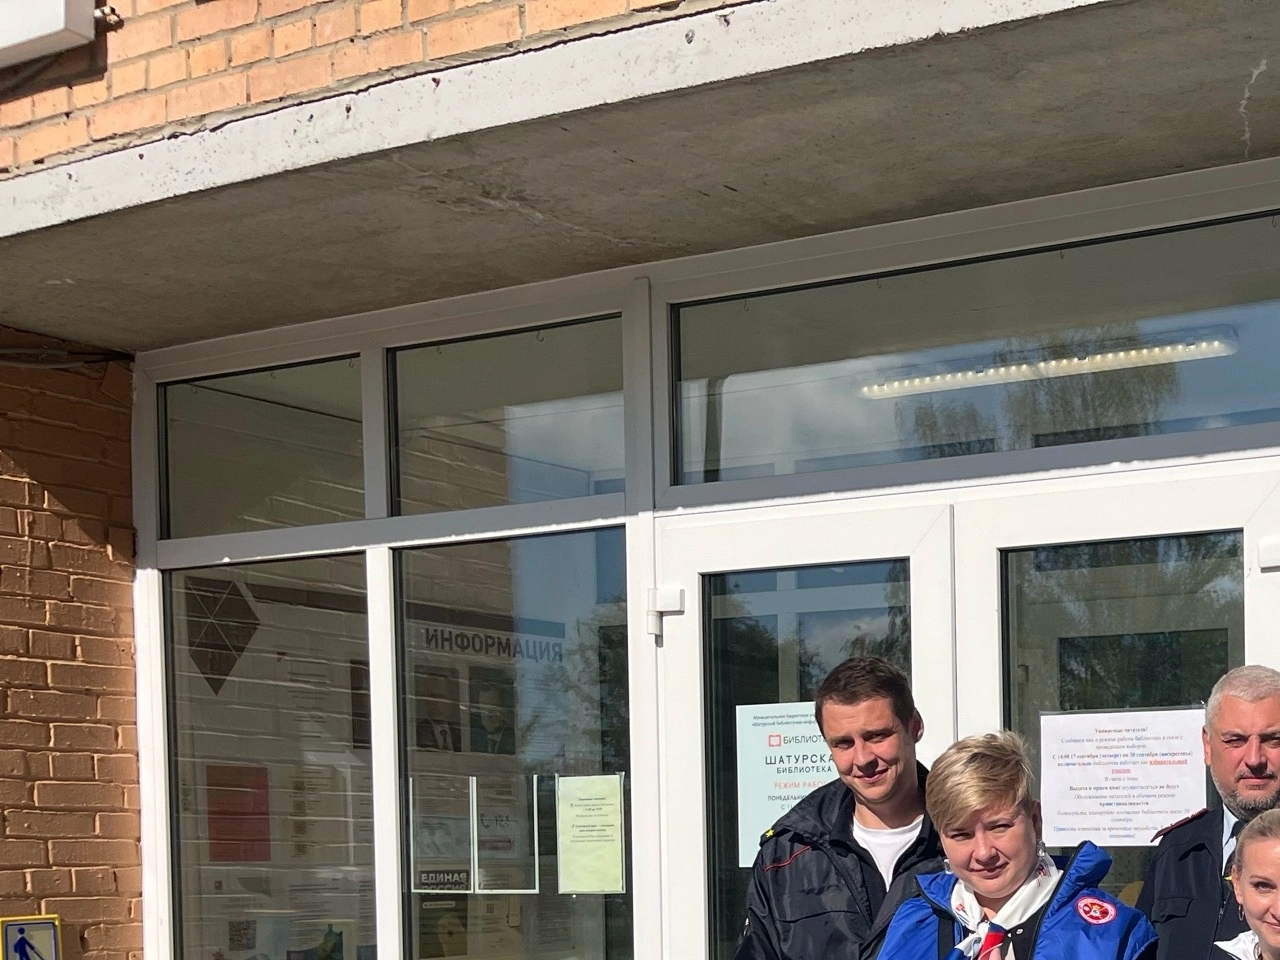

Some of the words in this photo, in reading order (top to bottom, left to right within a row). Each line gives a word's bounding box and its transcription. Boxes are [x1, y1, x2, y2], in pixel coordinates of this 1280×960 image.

[424, 628, 564, 663] ИНФОРМАЦИЯ
[777, 766, 832, 774] БИБЛИОТЕКА
[774, 782, 800, 790] РЕЖИМ
[421, 872, 467, 883] ЕДИНАЯ
